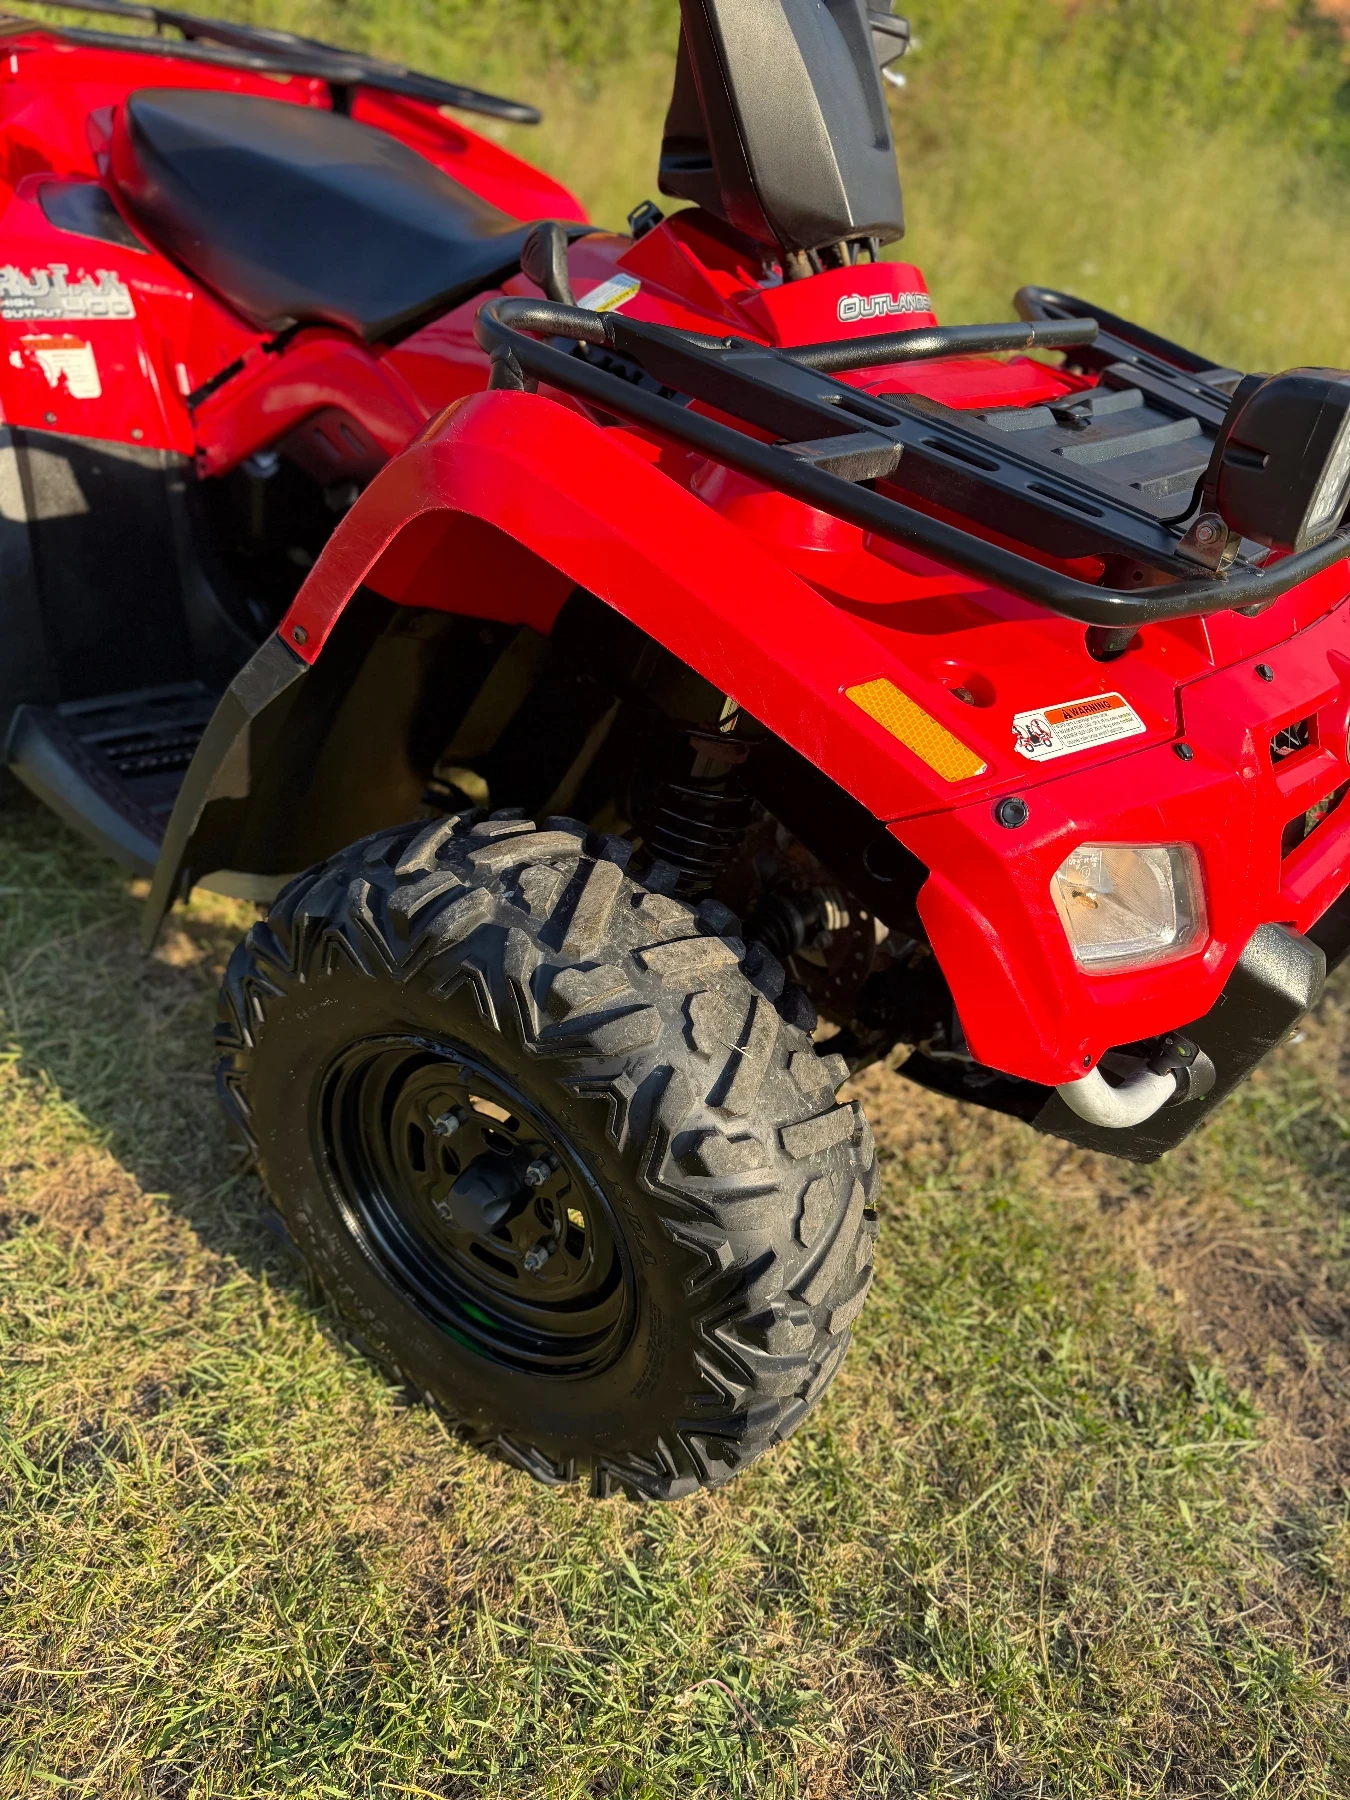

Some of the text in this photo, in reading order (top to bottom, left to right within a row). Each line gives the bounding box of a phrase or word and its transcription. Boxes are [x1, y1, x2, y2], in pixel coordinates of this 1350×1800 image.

[2, 308, 63, 319] OUTPUT
[838, 293, 931, 322] OUTLANDE
[1070, 700, 1112, 717] WARNING
